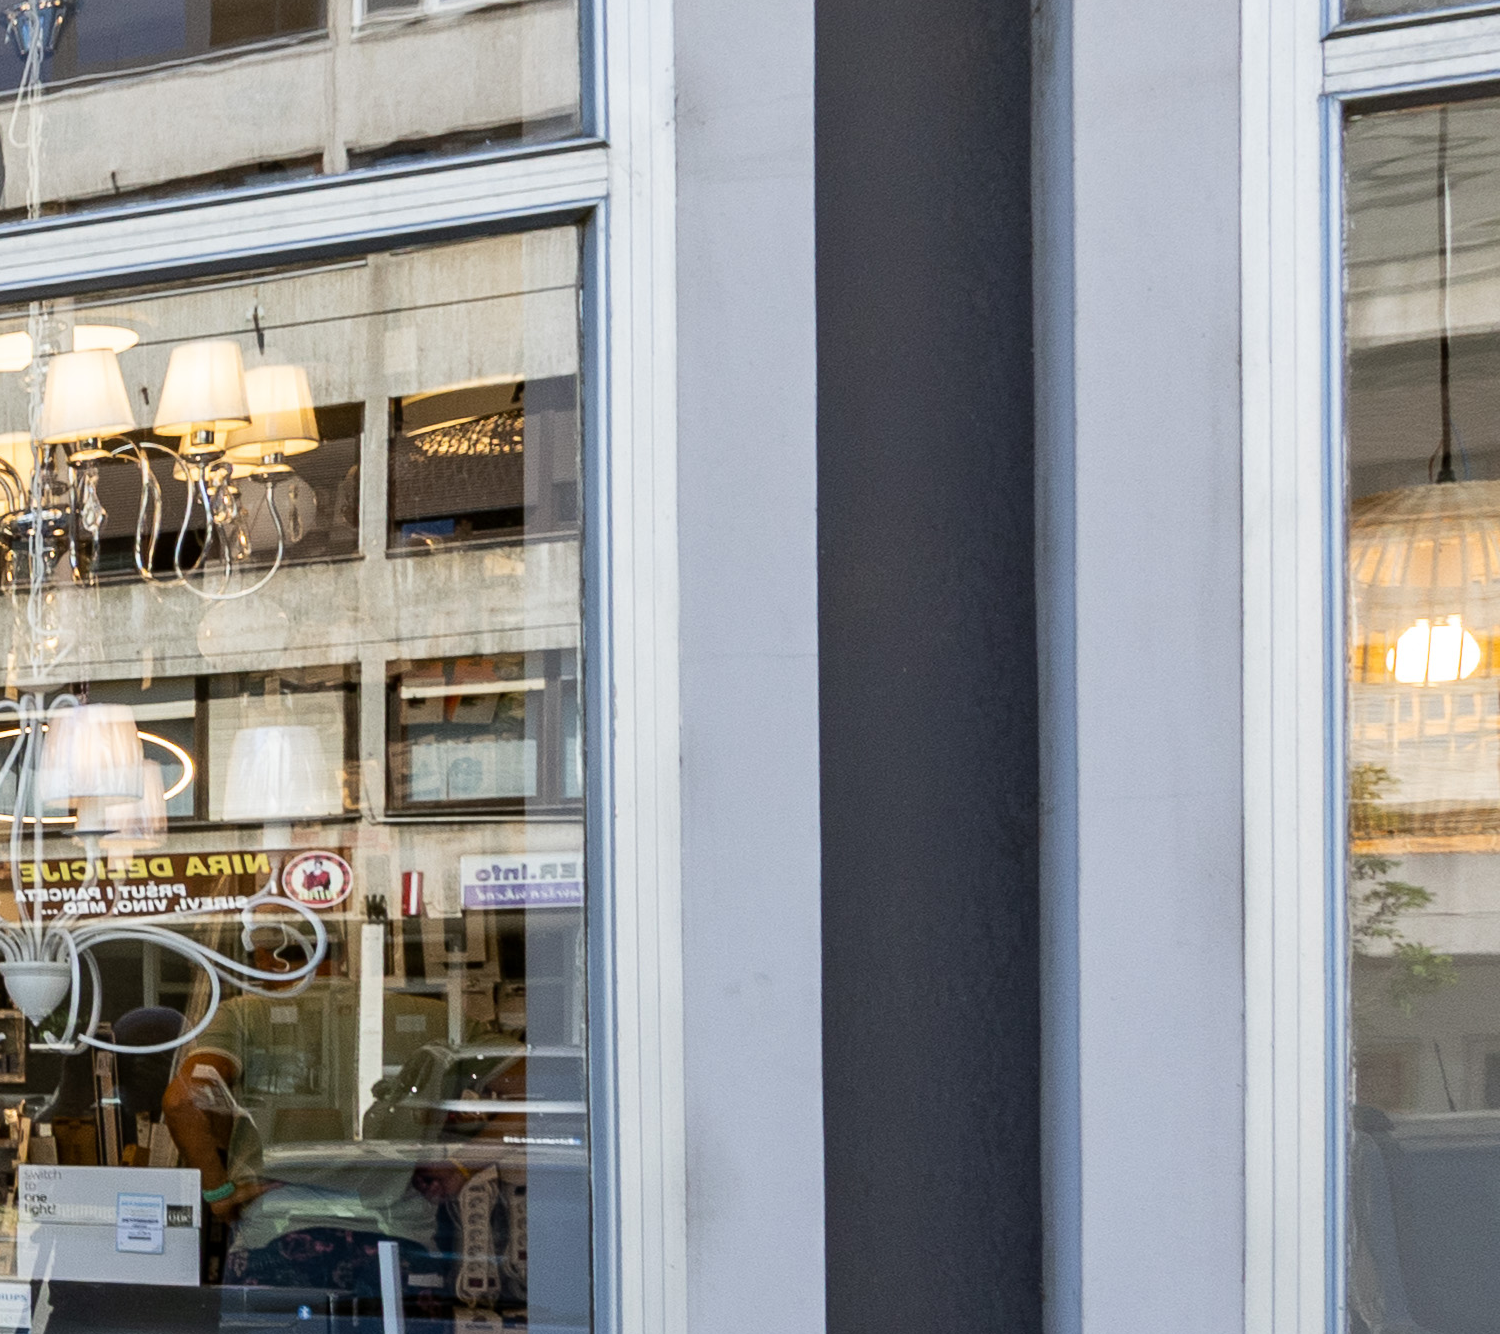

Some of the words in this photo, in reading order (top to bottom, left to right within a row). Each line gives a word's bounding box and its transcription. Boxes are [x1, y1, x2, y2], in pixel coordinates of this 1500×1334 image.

[23, 1169, 62, 1181] switch
[24, 1182, 36, 1191] to
[24, 1194, 47, 1203] one
[24, 1203, 56, 1216] light!
